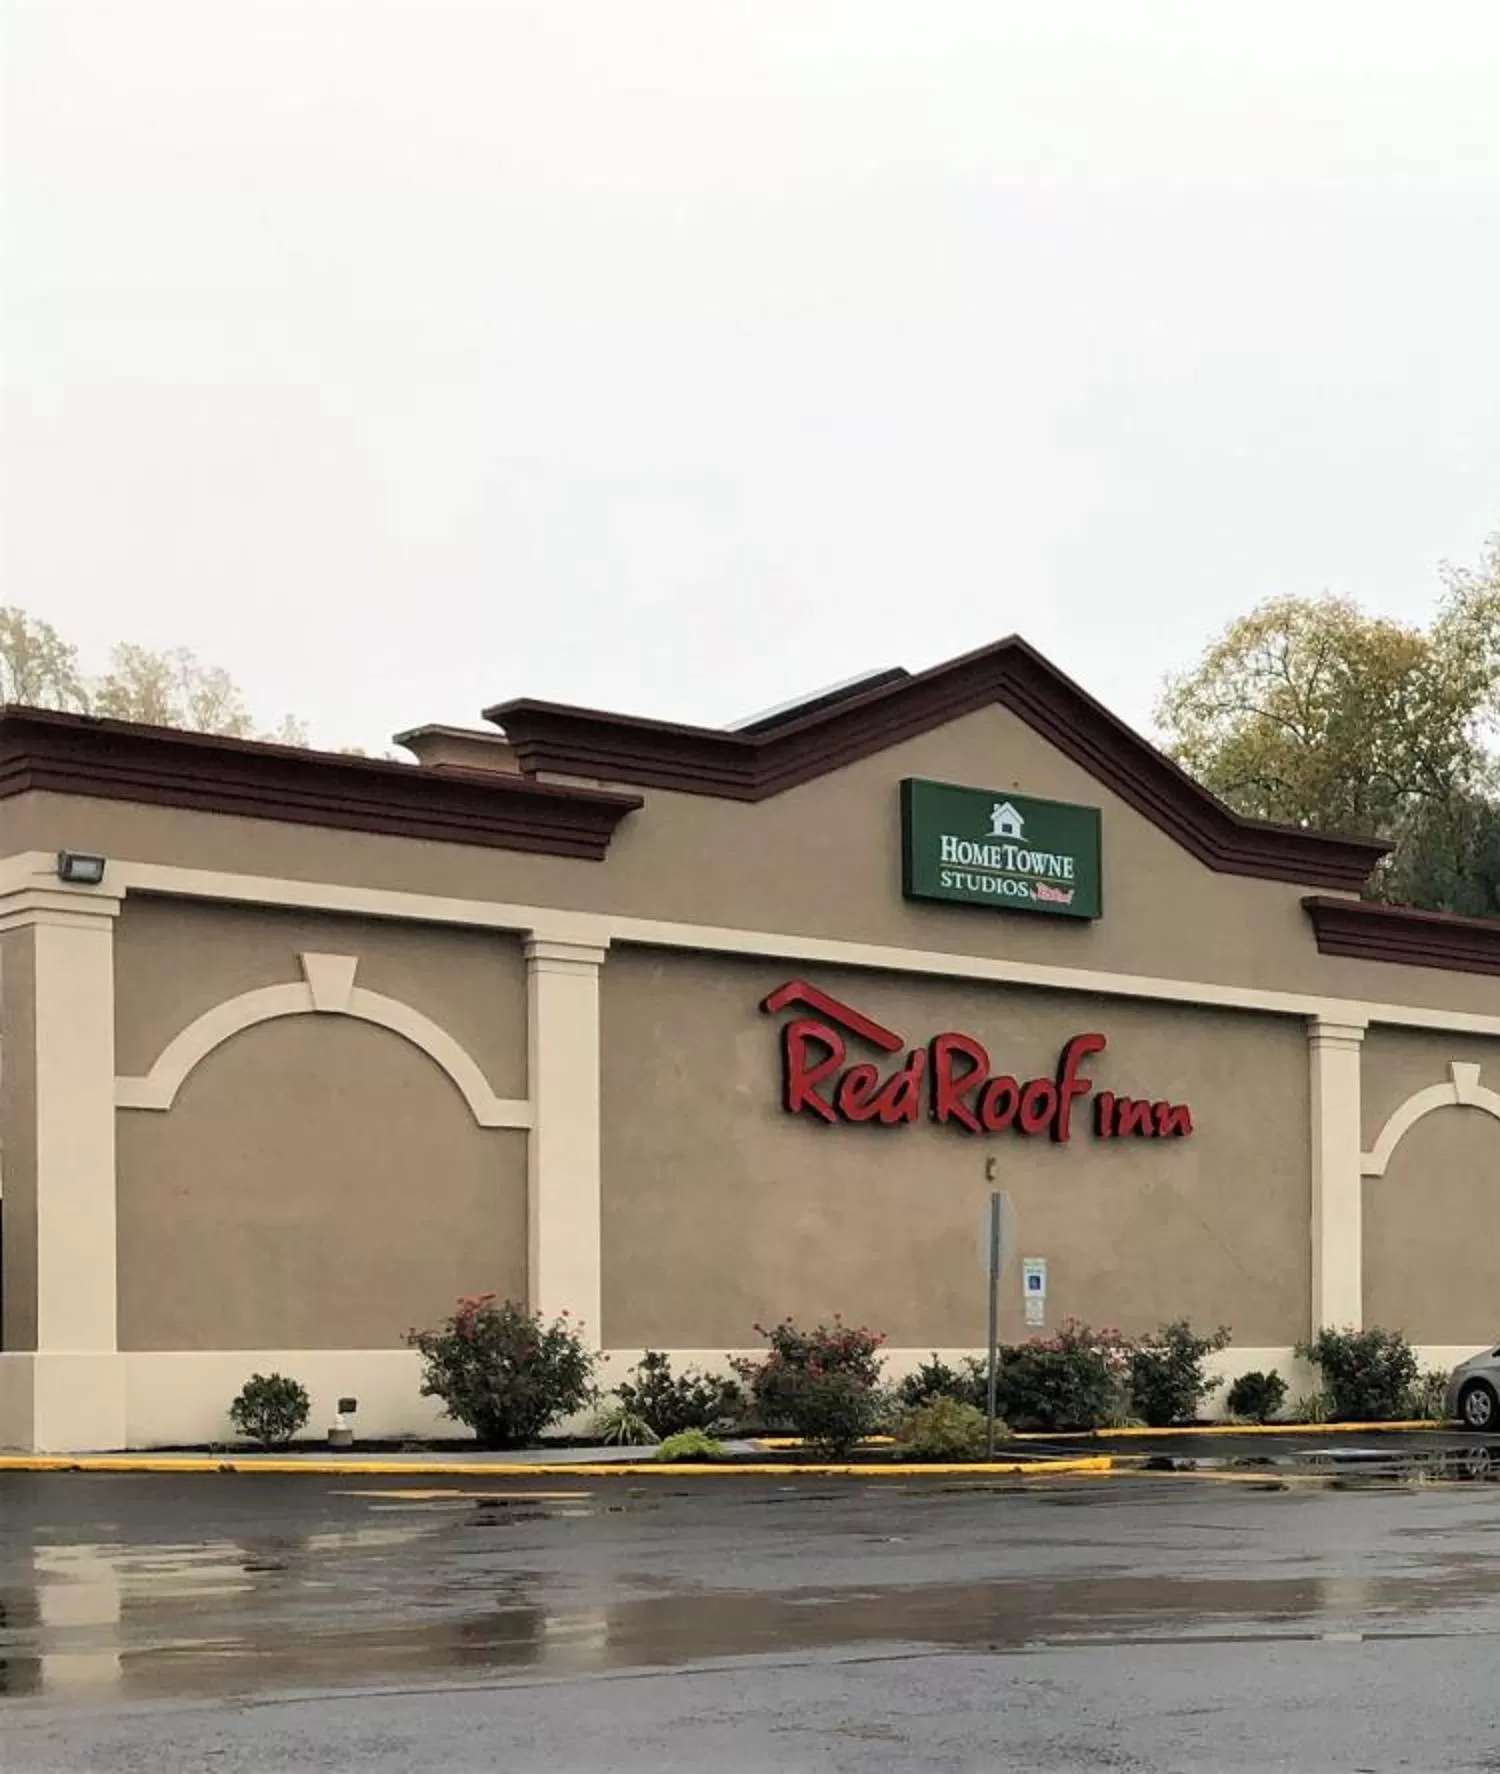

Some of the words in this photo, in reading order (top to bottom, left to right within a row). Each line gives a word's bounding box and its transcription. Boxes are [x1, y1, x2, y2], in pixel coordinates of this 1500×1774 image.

[941, 871, 1029, 897] STUDIOS
[783, 1018, 927, 1124] Red
[930, 1032, 1106, 1142] Roof
